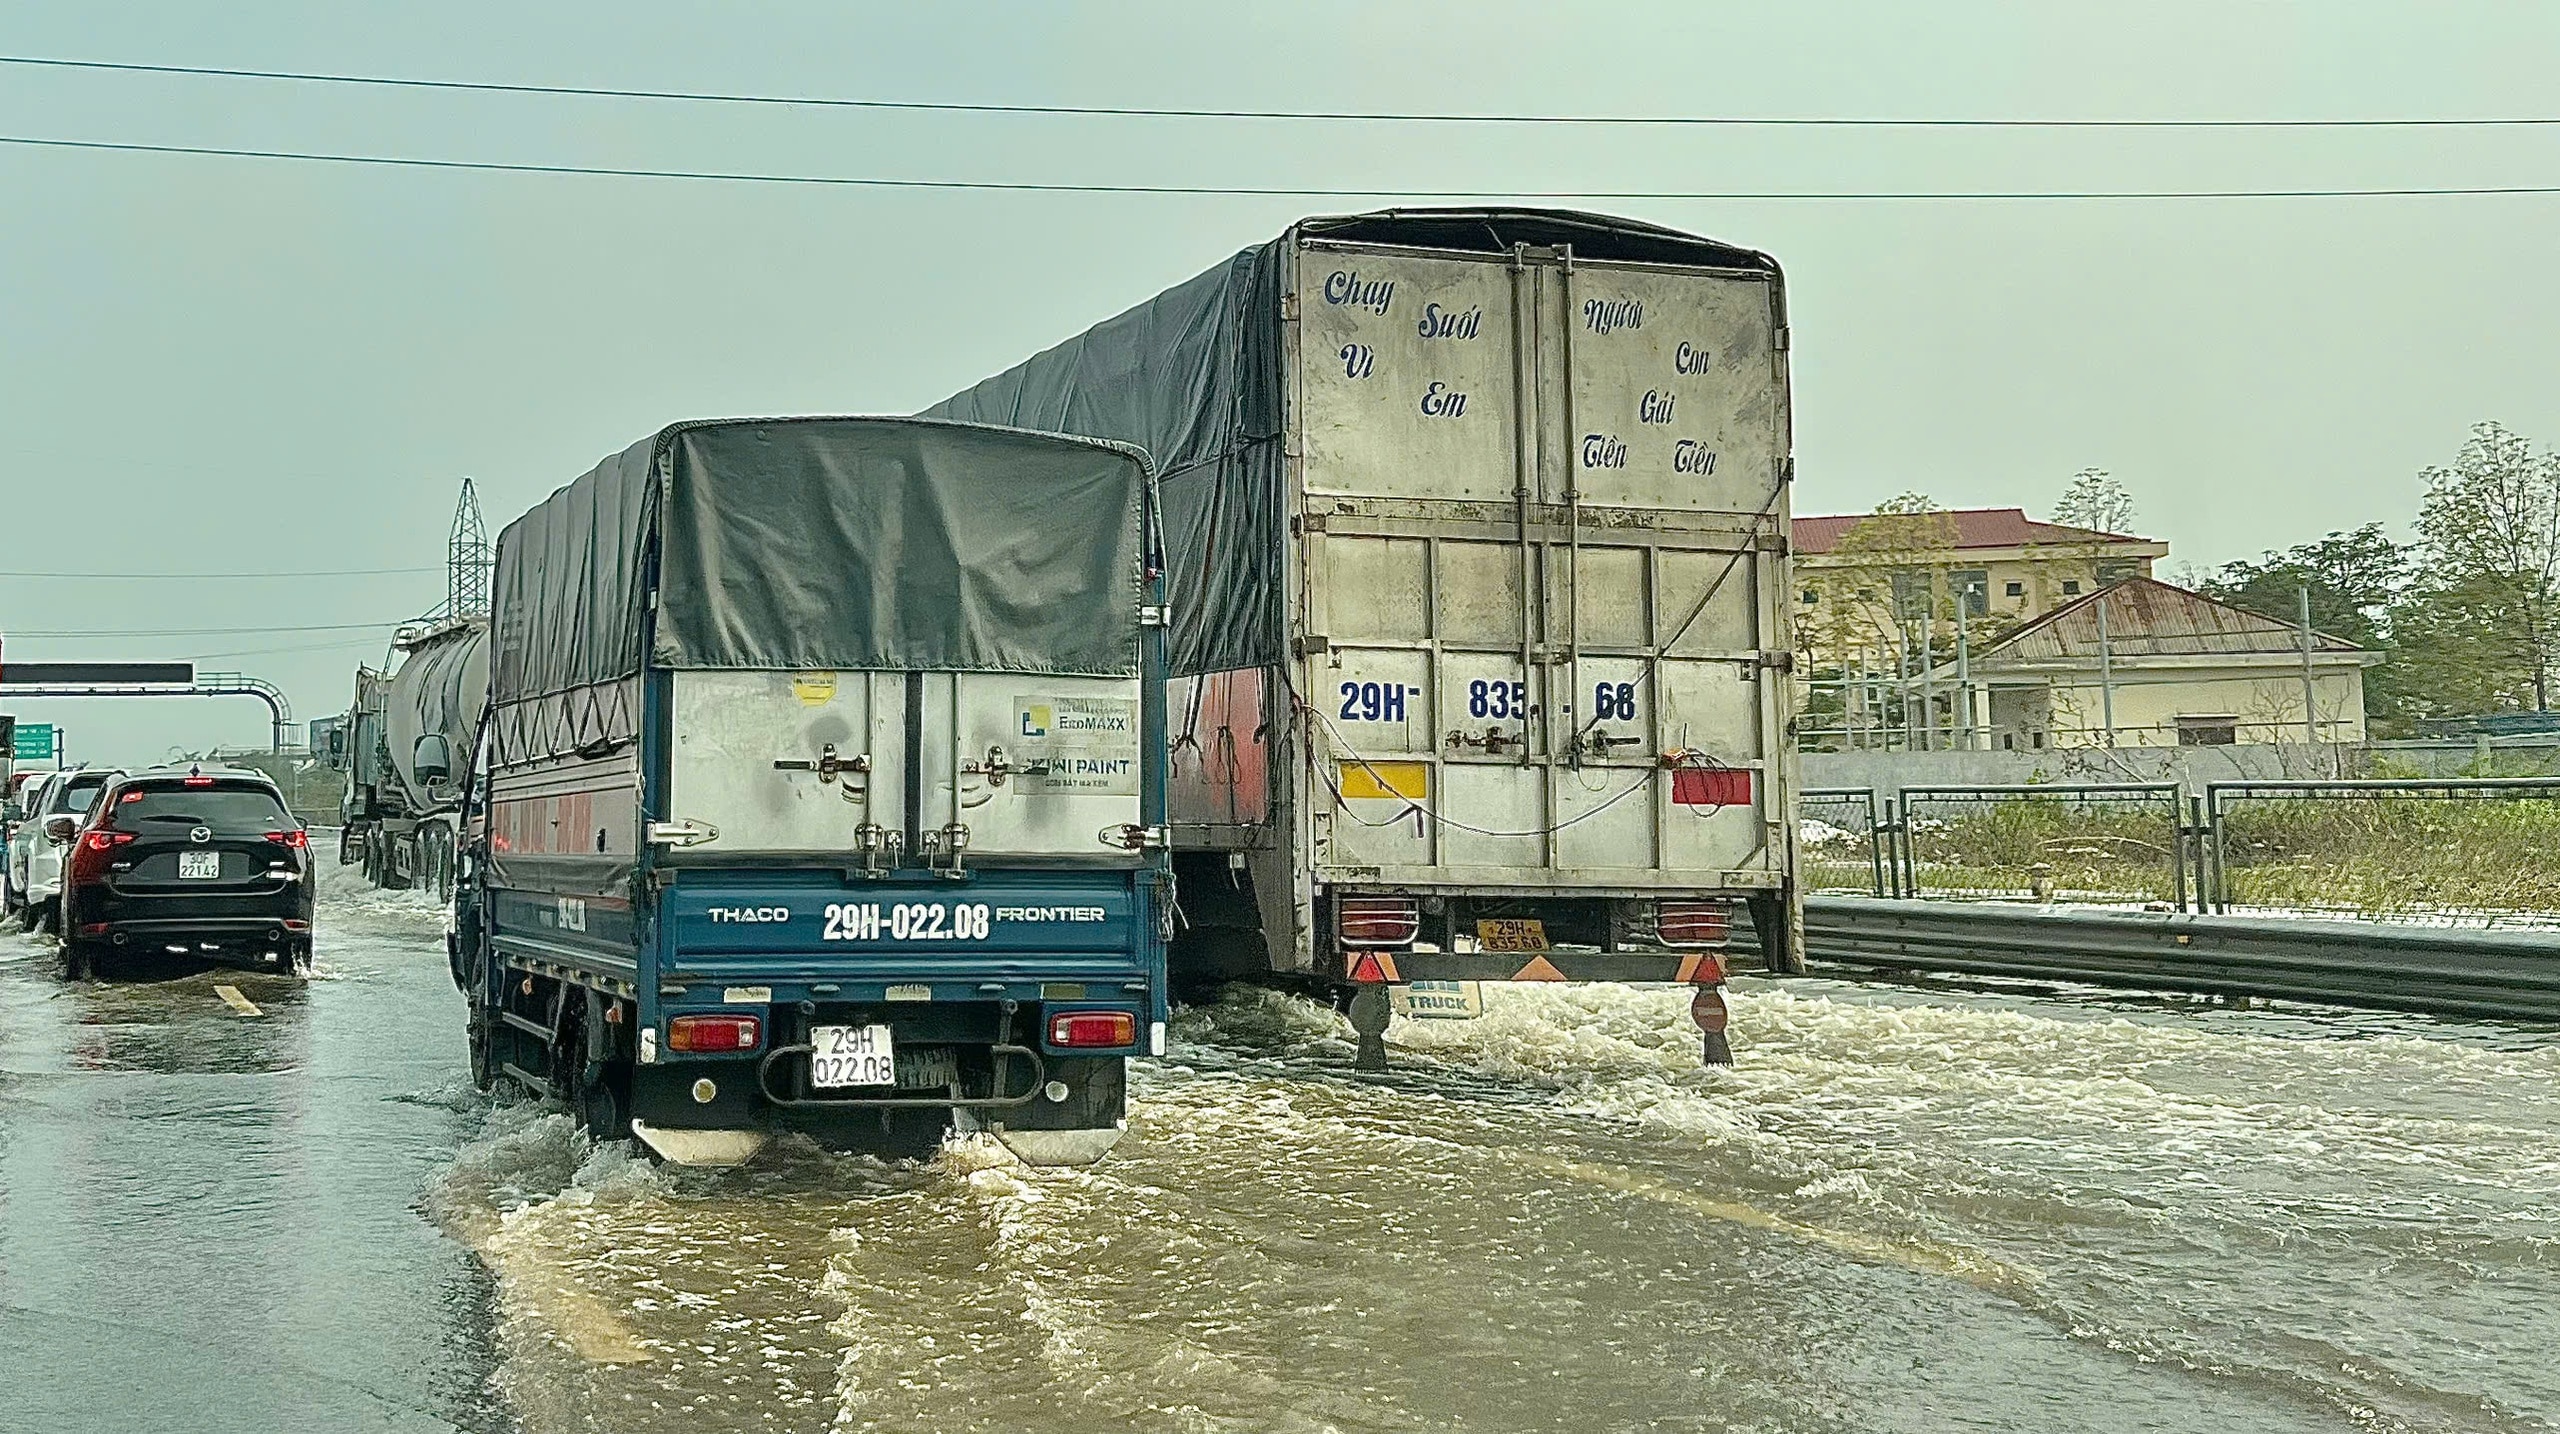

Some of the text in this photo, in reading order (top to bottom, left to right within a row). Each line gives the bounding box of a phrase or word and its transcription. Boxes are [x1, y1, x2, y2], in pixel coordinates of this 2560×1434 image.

[1324, 270, 1395, 316] Chạy
[1340, 343, 1374, 379] Vì
[1675, 341, 1710, 375] Con
[1420, 381, 1467, 417] Em
[1639, 389, 1675, 425] Gái
[1674, 439, 1717, 476] Tiền
[1077, 760, 1130, 775] PAINT
[708, 902, 1105, 940] THACO 29H-022.08 FRONTIER
[1407, 996, 1470, 1010] TRUCK
[830, 1027, 874, 1054] 29H
[815, 1056, 892, 1083] 022.08
